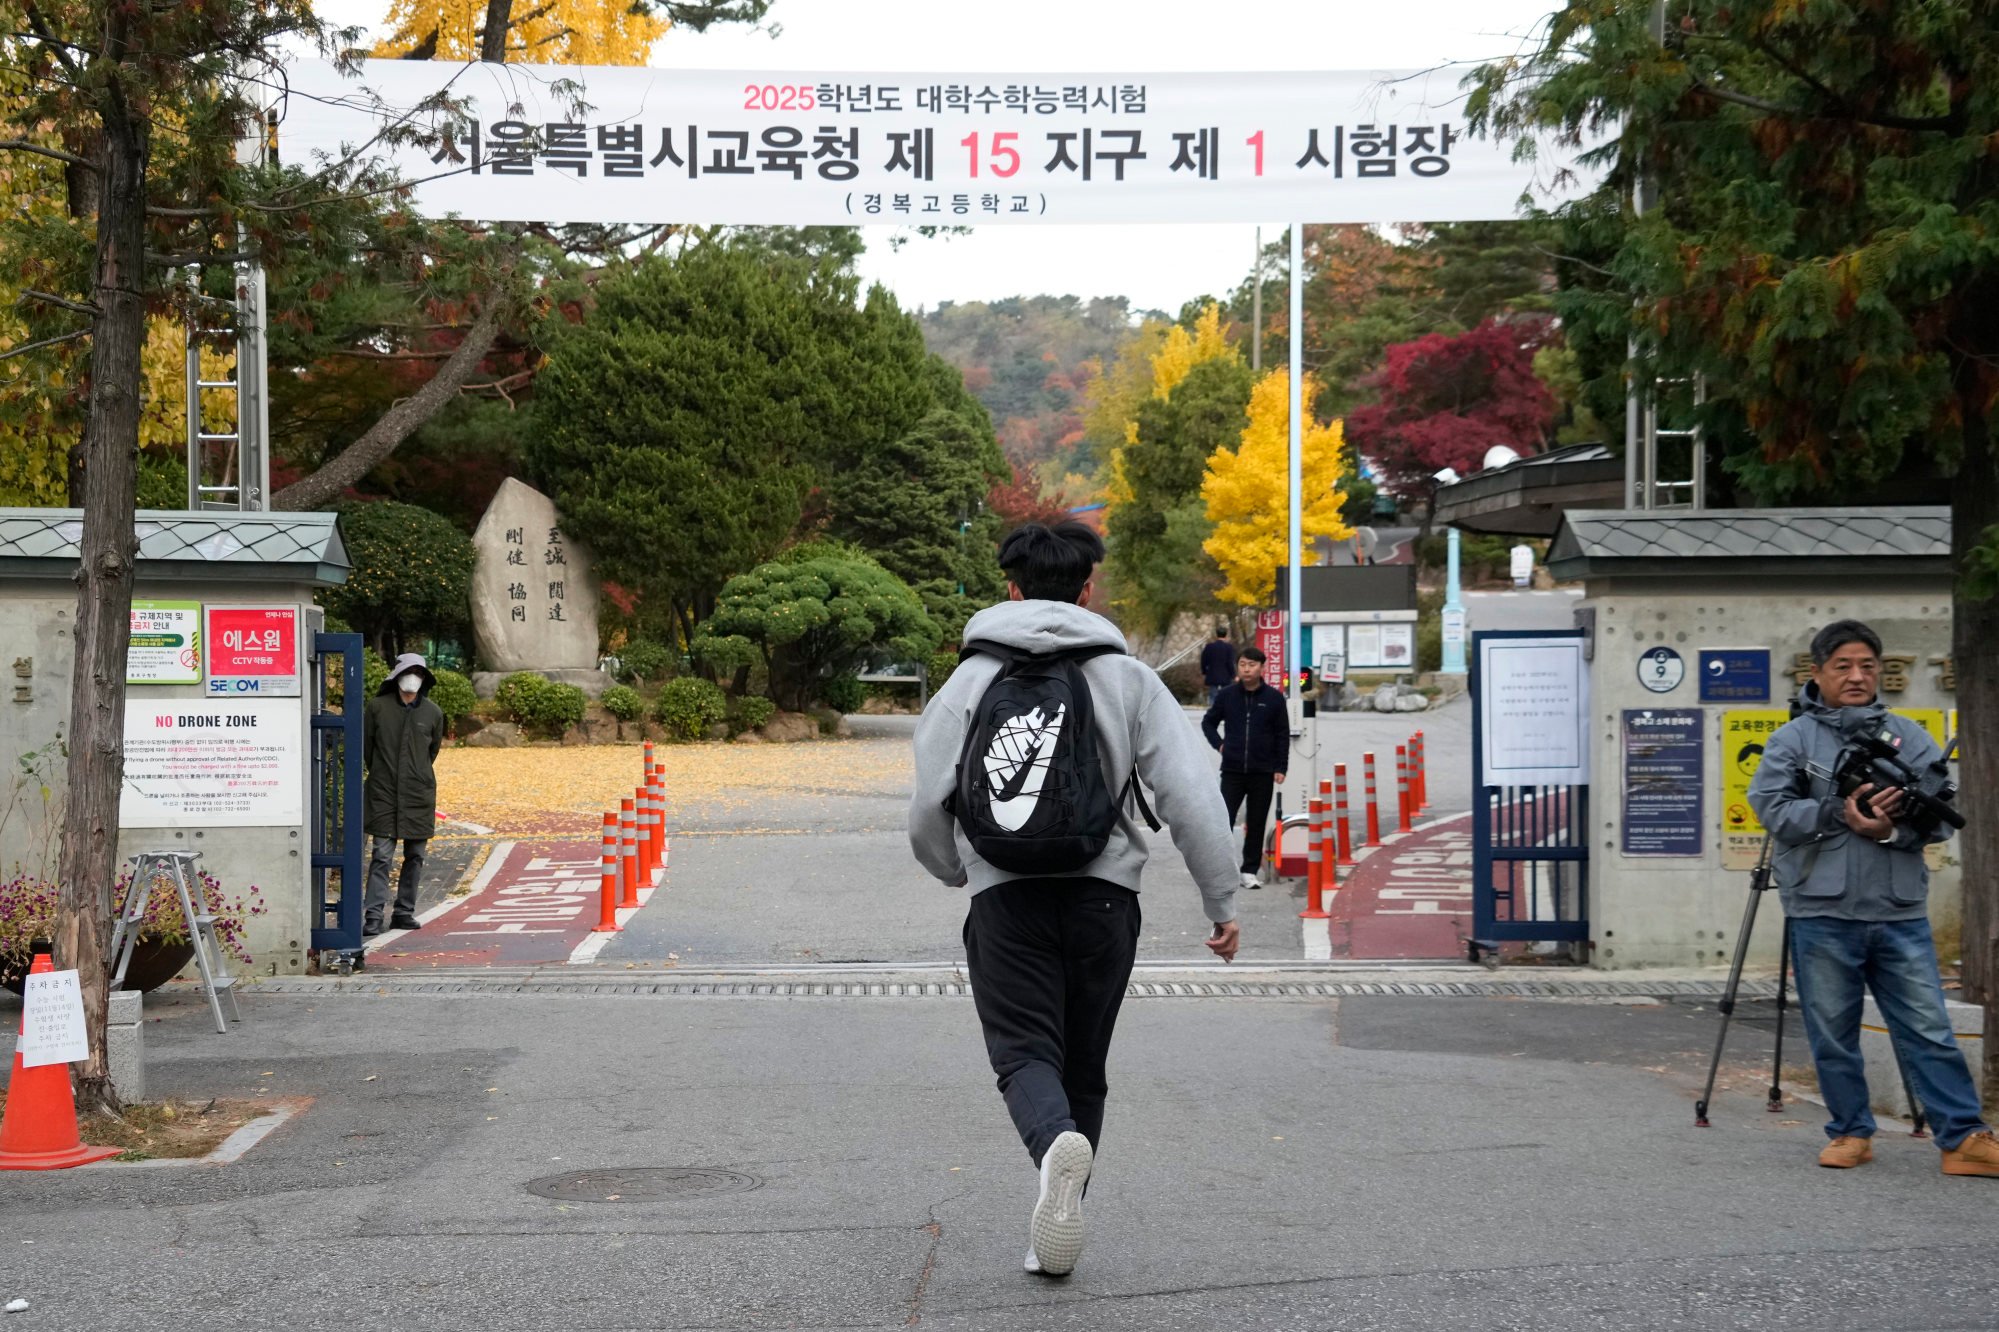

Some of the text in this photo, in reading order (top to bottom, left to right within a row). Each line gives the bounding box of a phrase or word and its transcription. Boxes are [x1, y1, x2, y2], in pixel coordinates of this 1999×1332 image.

[744, 84, 1147, 114] 2025학년도 대학수학능력시험
[431, 119, 1456, 182] 서울특별시교육청 제 15 지구 제 1 시험장
[139, 612, 173, 621] 규제지역
[153, 622, 170, 630] 안내
[223, 630, 281, 652] 에스원
[232, 656, 274, 665] CCTV 작동중
[1656, 666, 1666, 678] 9
[210, 680, 259, 692] SECOM
[156, 716, 257, 728] NO DRONE ZONE
